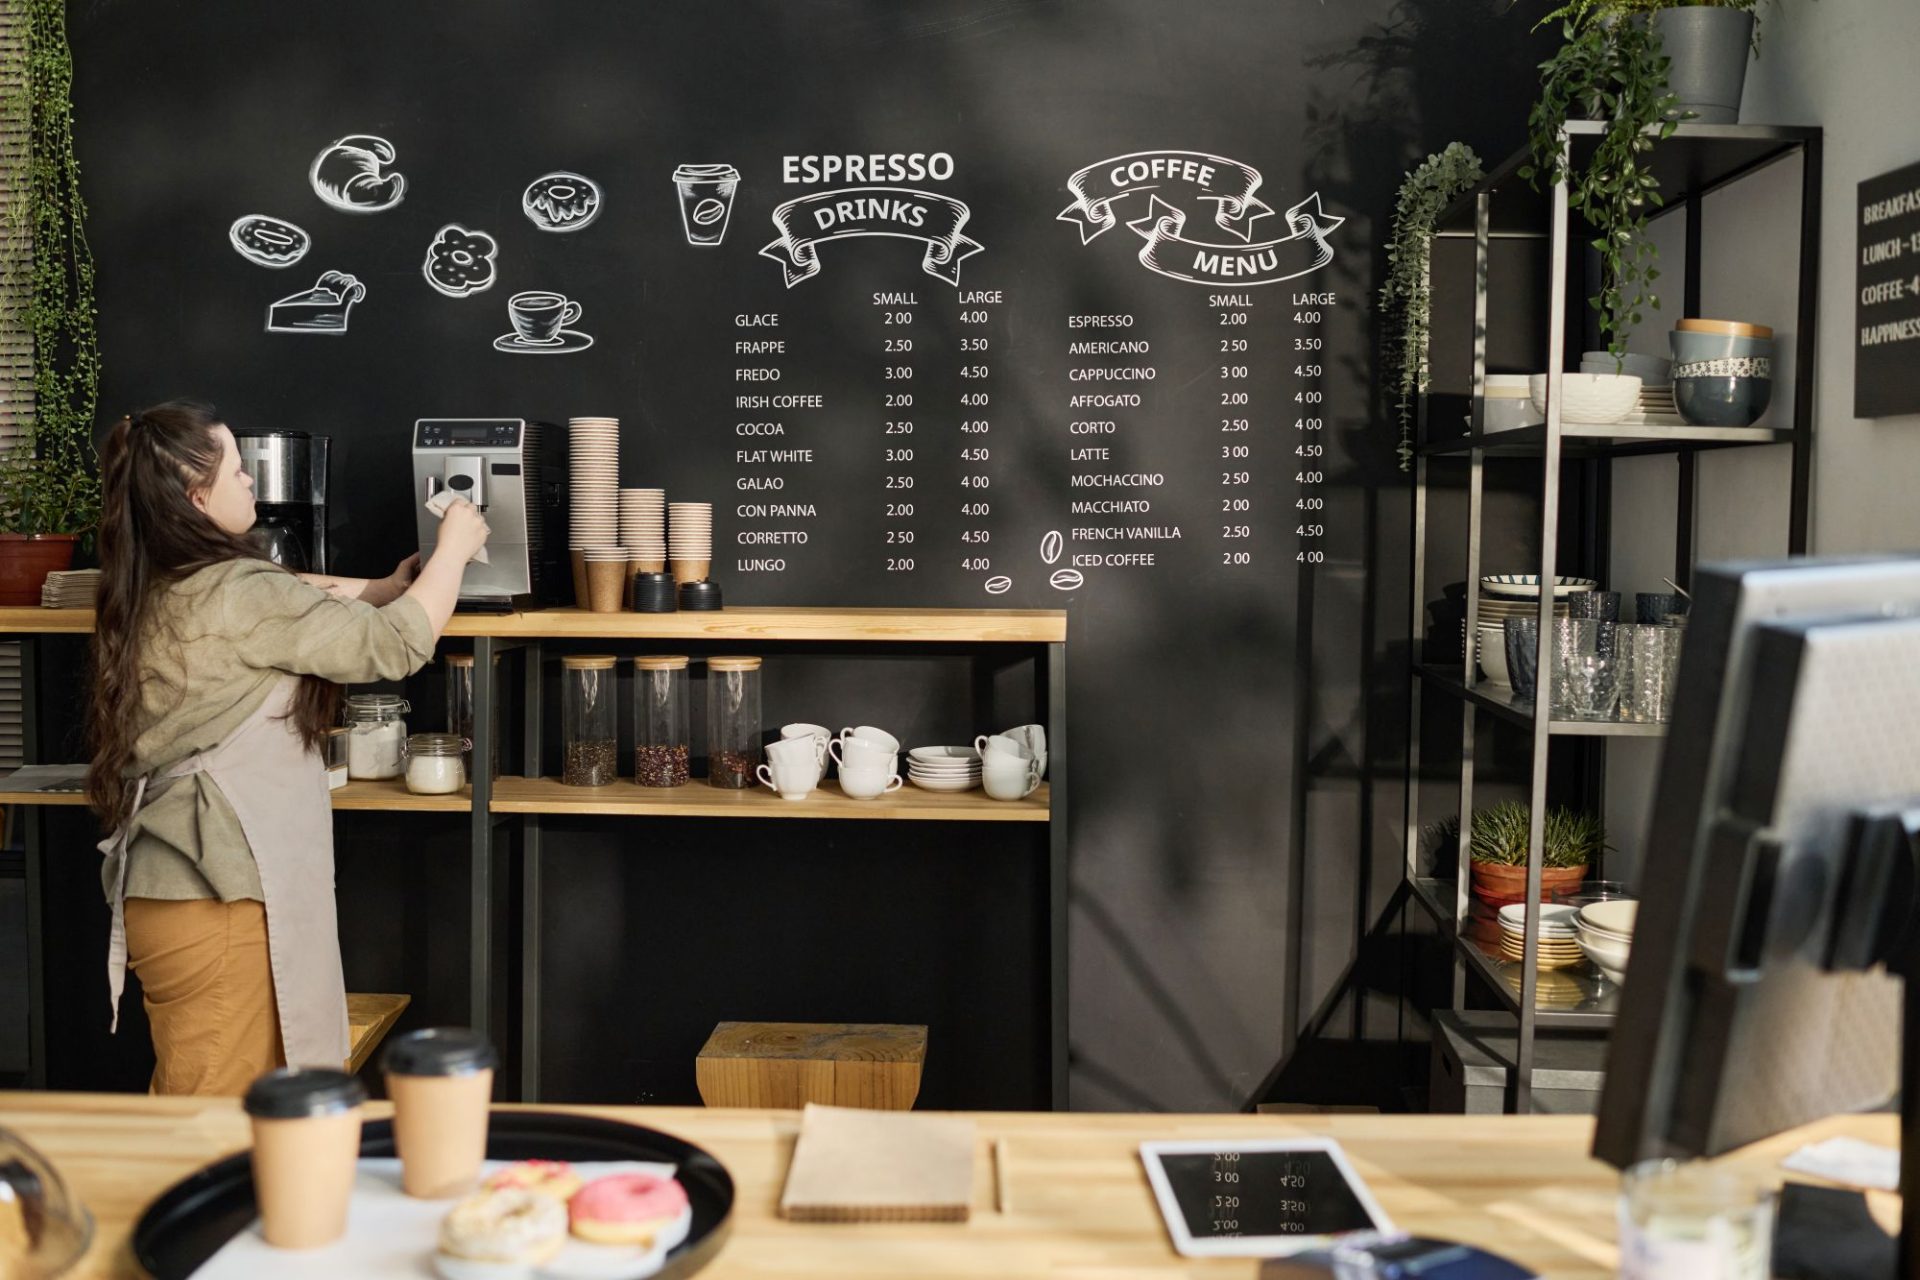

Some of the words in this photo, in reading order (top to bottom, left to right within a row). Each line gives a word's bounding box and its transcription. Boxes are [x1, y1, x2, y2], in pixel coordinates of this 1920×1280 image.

[782, 152, 955, 183] ESPRESSO
[1110, 158, 1216, 187] COFFEE
[813, 198, 928, 230] DRINKS
[1192, 249, 1279, 276] MENU
[872, 291, 919, 306] SMALL
[958, 290, 1003, 305] LARGE
[1208, 294, 1254, 308] SMALL
[1292, 292, 1336, 306] LARGE
[734, 313, 779, 328] GLACE
[959, 310, 988, 324] 4.00
[1068, 314, 1134, 329] ESPRESSO
[1219, 312, 1248, 326] 2.00
[1293, 311, 1321, 324] 4.00
[735, 340, 786, 355] FRAPPE
[884, 339, 913, 353] 2.50
[960, 338, 989, 352] 3.50
[1068, 340, 1150, 355] AMERICANO
[1294, 338, 1322, 351] 3.50
[735, 367, 781, 382] FREDO
[884, 366, 913, 380] 3.00
[959, 365, 989, 379] 4.50
[1068, 367, 1156, 382] CAPPUCCINO
[1293, 364, 1322, 377] 4.50
[735, 395, 770, 409] IRISH
[772, 394, 823, 409] COFFEE
[885, 393, 913, 407] 2.00
[960, 392, 989, 406] 4.00
[1069, 393, 1142, 408] AFFOGATO
[1221, 392, 1249, 406] 2.00
[735, 422, 785, 436] COCOA
[885, 421, 914, 435] 2.50
[960, 420, 989, 434] 4.00
[1069, 420, 1116, 435] CORTO
[1221, 418, 1249, 432] 2.50
[736, 449, 769, 463] FLAT
[769, 449, 813, 463] WHITE
[885, 448, 914, 462] 3.00
[960, 447, 990, 461] 4.50
[1070, 447, 1110, 461] LATTE
[1294, 444, 1323, 457] 4.50
[736, 476, 785, 491] GALAO
[885, 475, 914, 489] 2.50
[1070, 473, 1165, 488] MOCHACCINO
[1295, 470, 1323, 484] 4.00
[736, 504, 767, 518] CON
[770, 504, 817, 518] PANNA
[886, 503, 914, 517] 2.00
[961, 502, 990, 516] 4.00
[1071, 500, 1150, 514] MACCHIATO
[1295, 497, 1324, 510] 4.00
[737, 531, 809, 545] CORRETTO
[961, 530, 990, 544] 4.50
[1071, 527, 1124, 541] FRENCH
[1125, 526, 1182, 540] VANILLA
[1222, 525, 1250, 538] 2.50
[1295, 524, 1324, 537] 4.50
[737, 558, 786, 572] LUNGO
[886, 558, 915, 571] 2.00
[961, 557, 990, 571] 4.00
[1072, 554, 1103, 567] ICED
[1105, 553, 1155, 567] COFFEE
